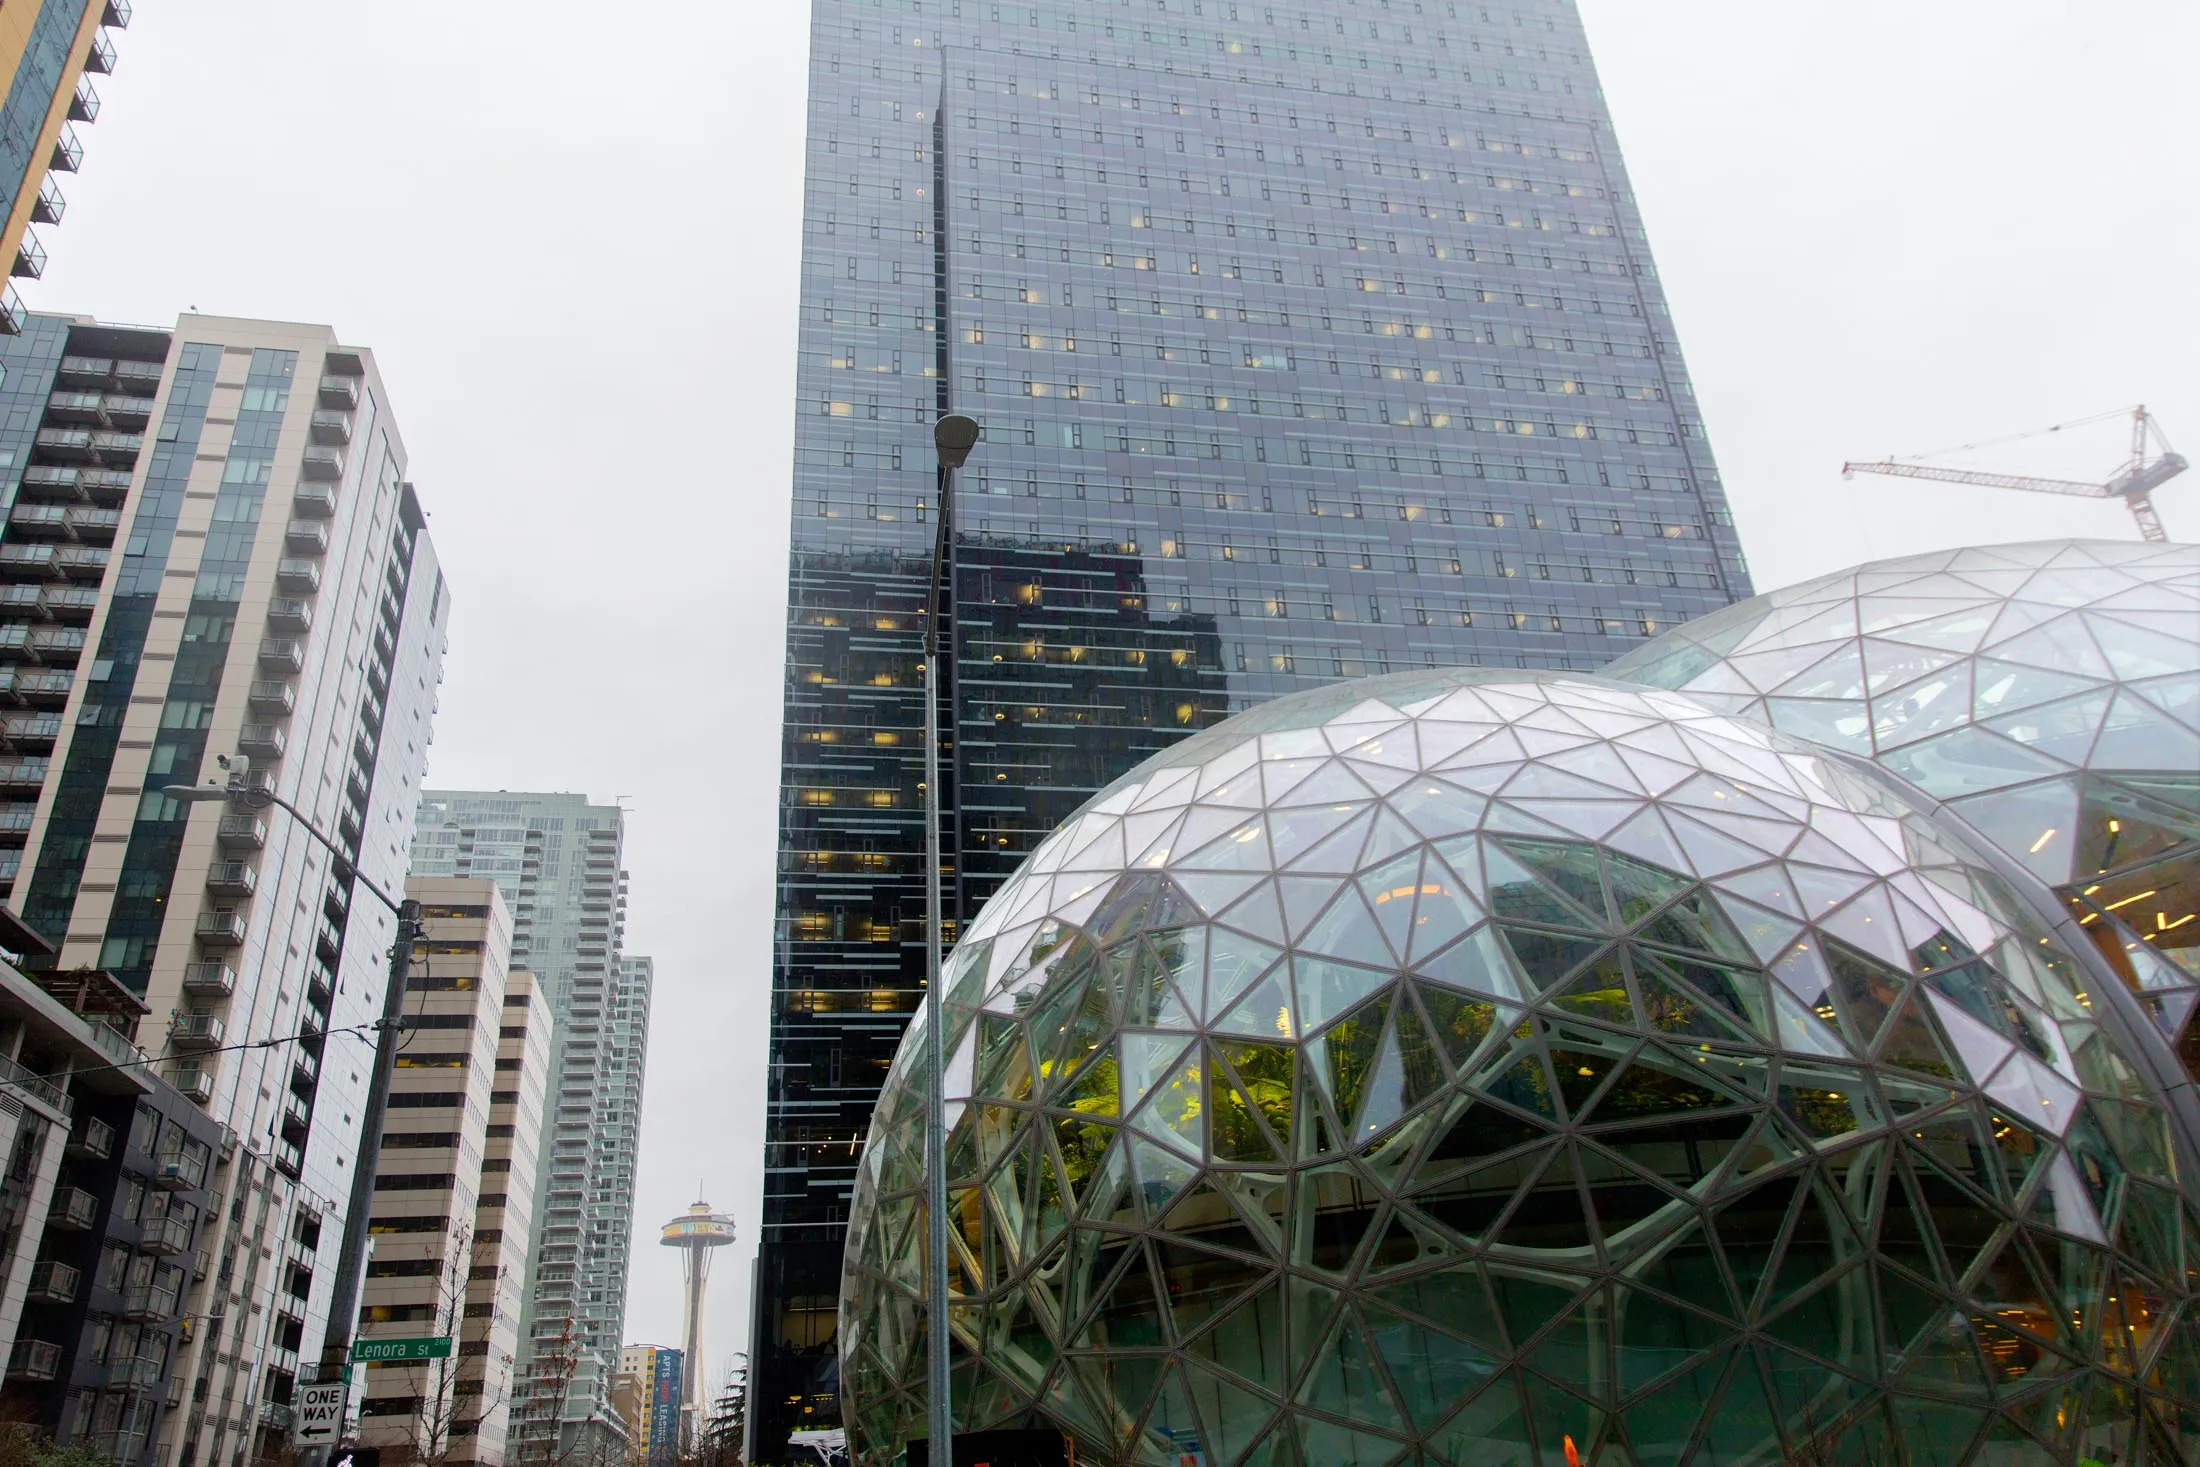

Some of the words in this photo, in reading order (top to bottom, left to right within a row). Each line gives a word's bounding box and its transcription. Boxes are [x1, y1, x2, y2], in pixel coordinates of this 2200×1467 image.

[434, 1338, 450, 1346] 2100
[355, 1342, 406, 1358] Lenora
[418, 1344, 429, 1356] St
[662, 1355, 671, 1378] APTS
[306, 1390, 340, 1404] ONE
[303, 1406, 339, 1421] WAY
[658, 1404, 668, 1443] LEASING
